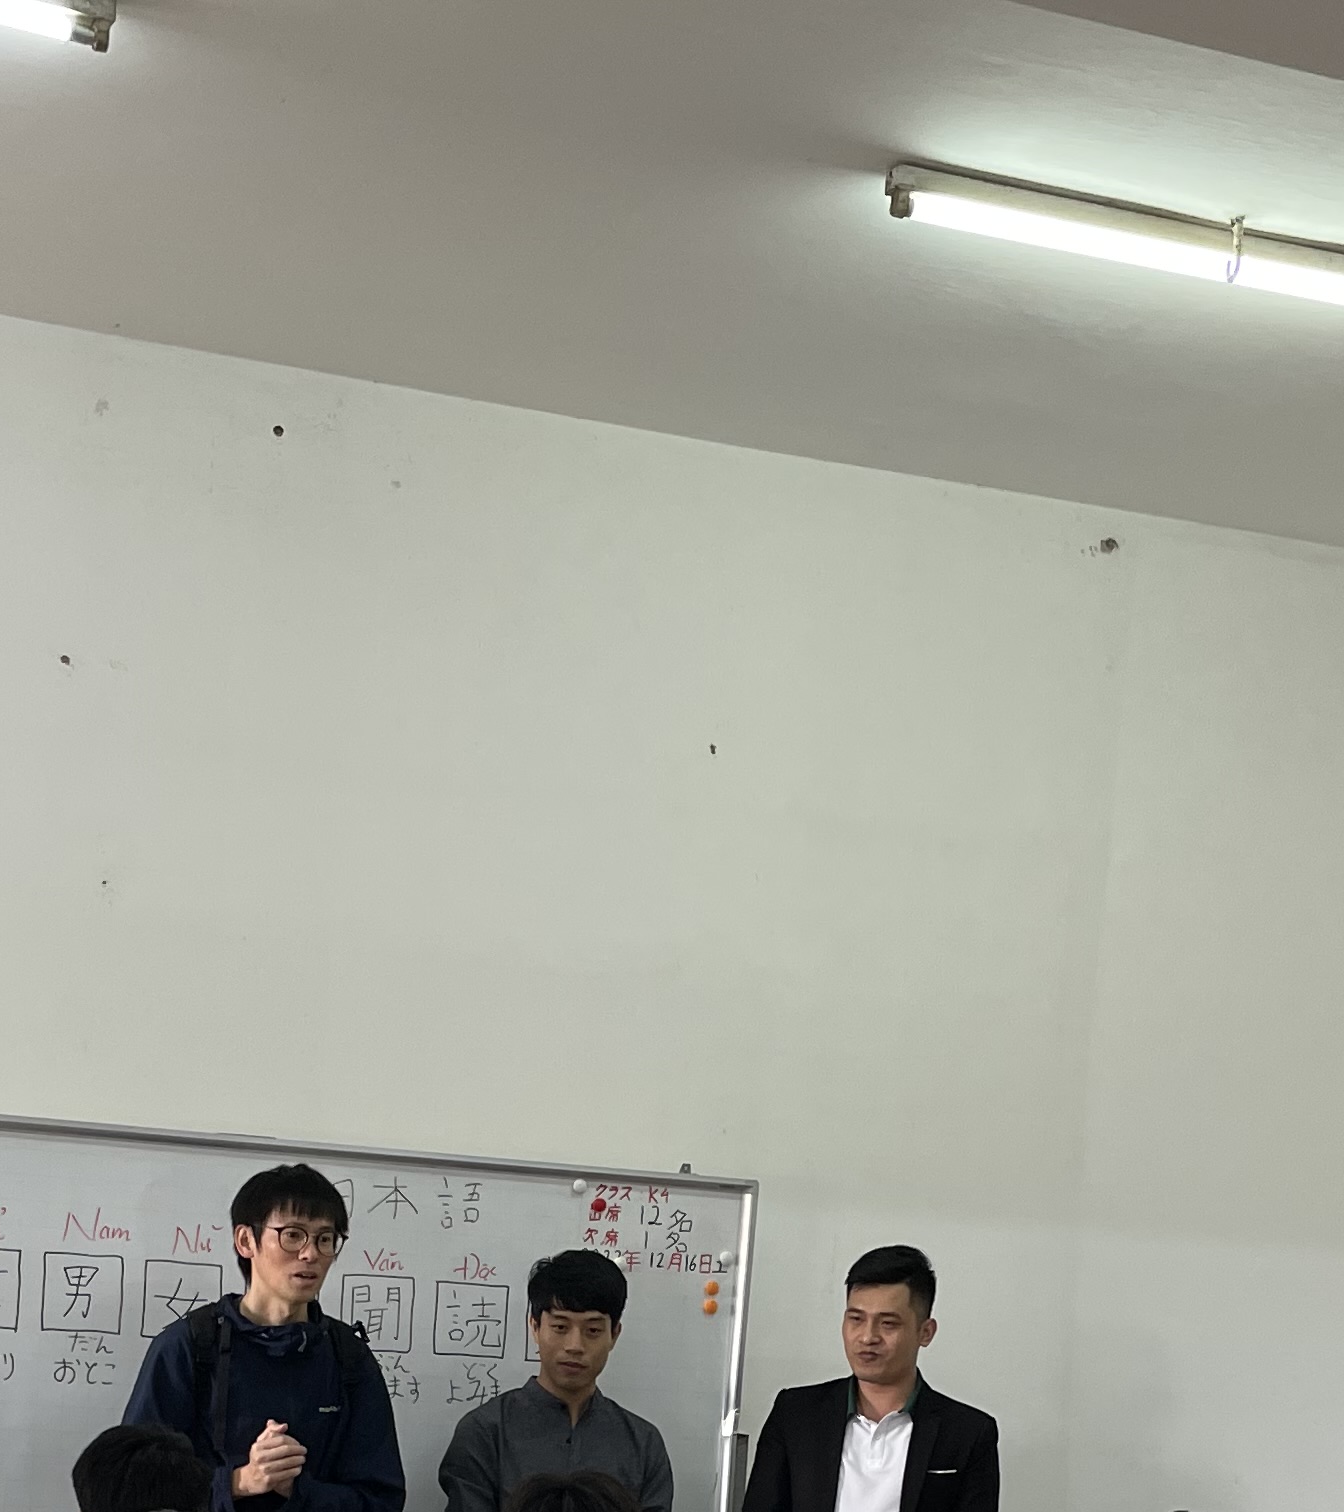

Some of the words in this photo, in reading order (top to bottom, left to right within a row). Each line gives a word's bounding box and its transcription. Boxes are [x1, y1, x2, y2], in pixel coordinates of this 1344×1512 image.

[596, 1184, 633, 1201] クラス
[62, 1207, 132, 1243] Nam
[63, 1265, 100, 1319] 男
[446, 1290, 502, 1348] 読
[53, 1358, 116, 1386] おとこ
